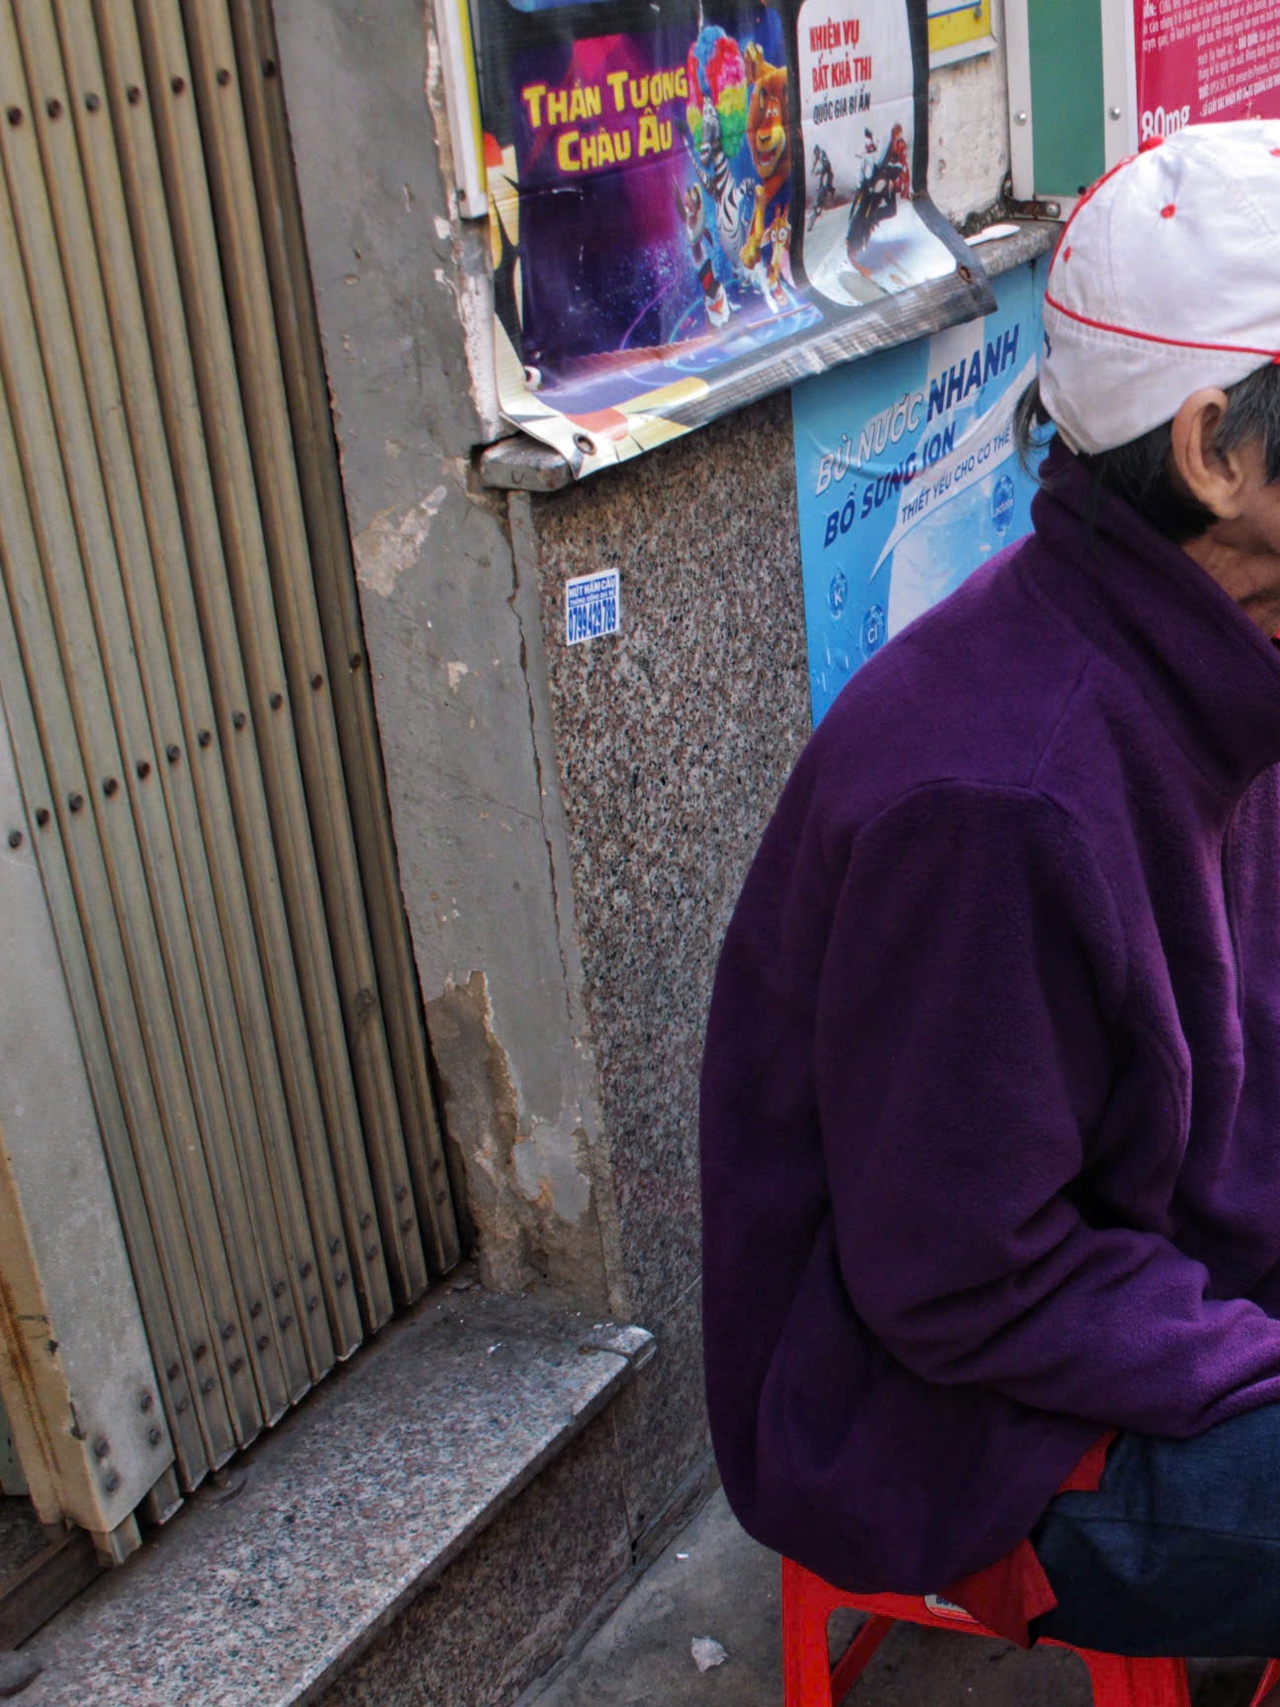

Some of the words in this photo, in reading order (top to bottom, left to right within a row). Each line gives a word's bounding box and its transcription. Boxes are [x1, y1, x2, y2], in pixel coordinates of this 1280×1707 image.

[810, 17, 842, 54] NHIỆM
[843, 19, 860, 50] VỤ
[522, 79, 602, 128] THẦN
[606, 67, 689, 112] TƯỢNG
[812, 53, 829, 94] BẤT
[831, 52, 852, 88] KHẢ
[853, 56, 872, 83] THI
[834, 98, 848, 119] GIA
[557, 127, 632, 172] CHÂU
[638, 107, 674, 157] ÂU
[815, 433, 852, 497] BÙ
[857, 393, 923, 468] NƯỚC
[926, 323, 1019, 423] NHANH
[824, 483, 855, 548] BỔ
[861, 452, 917, 519] SUNG
[922, 421, 956, 468] ION
[954, 454, 975, 482] CHO
